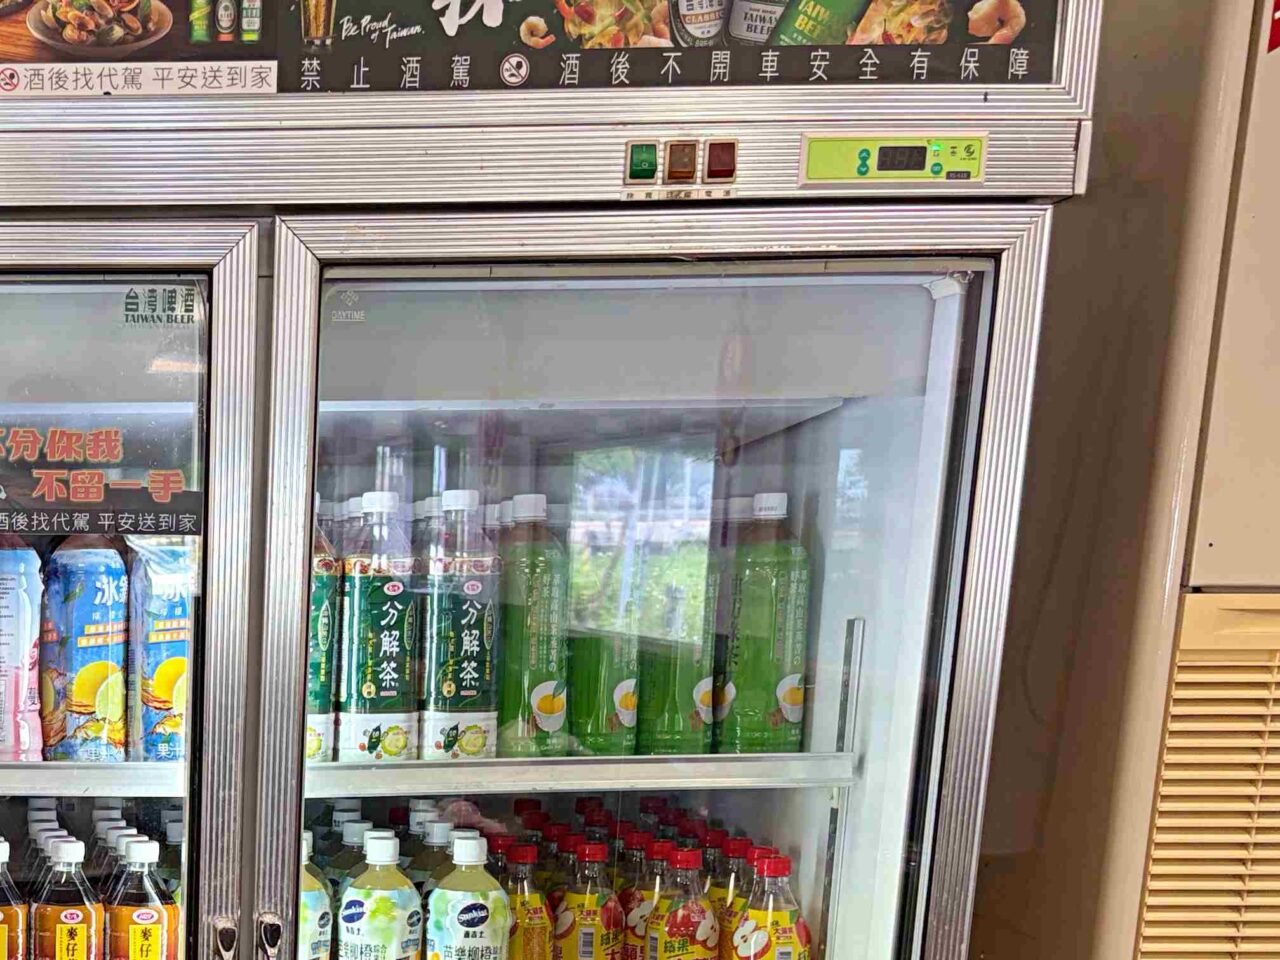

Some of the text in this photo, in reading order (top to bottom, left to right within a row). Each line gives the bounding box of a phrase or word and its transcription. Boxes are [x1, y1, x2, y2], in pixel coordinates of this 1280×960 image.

[340, 12, 392, 41] Be Proud
[23, 66, 143, 91] 酒後找代駕
[152, 65, 273, 90] 平安送到家
[300, 48, 1030, 90] 禁止酒駕 酒後不開車安全有保障
[124, 313, 195, 325] TAIWAN BEER
[32, 469, 185, 503] 不留一手
[97, 512, 197, 531] 平安送到家
[378, 600, 403, 688] 分解茶
[459, 600, 482, 688] 分解茶
[458, 906, 489, 922] Sunkist
